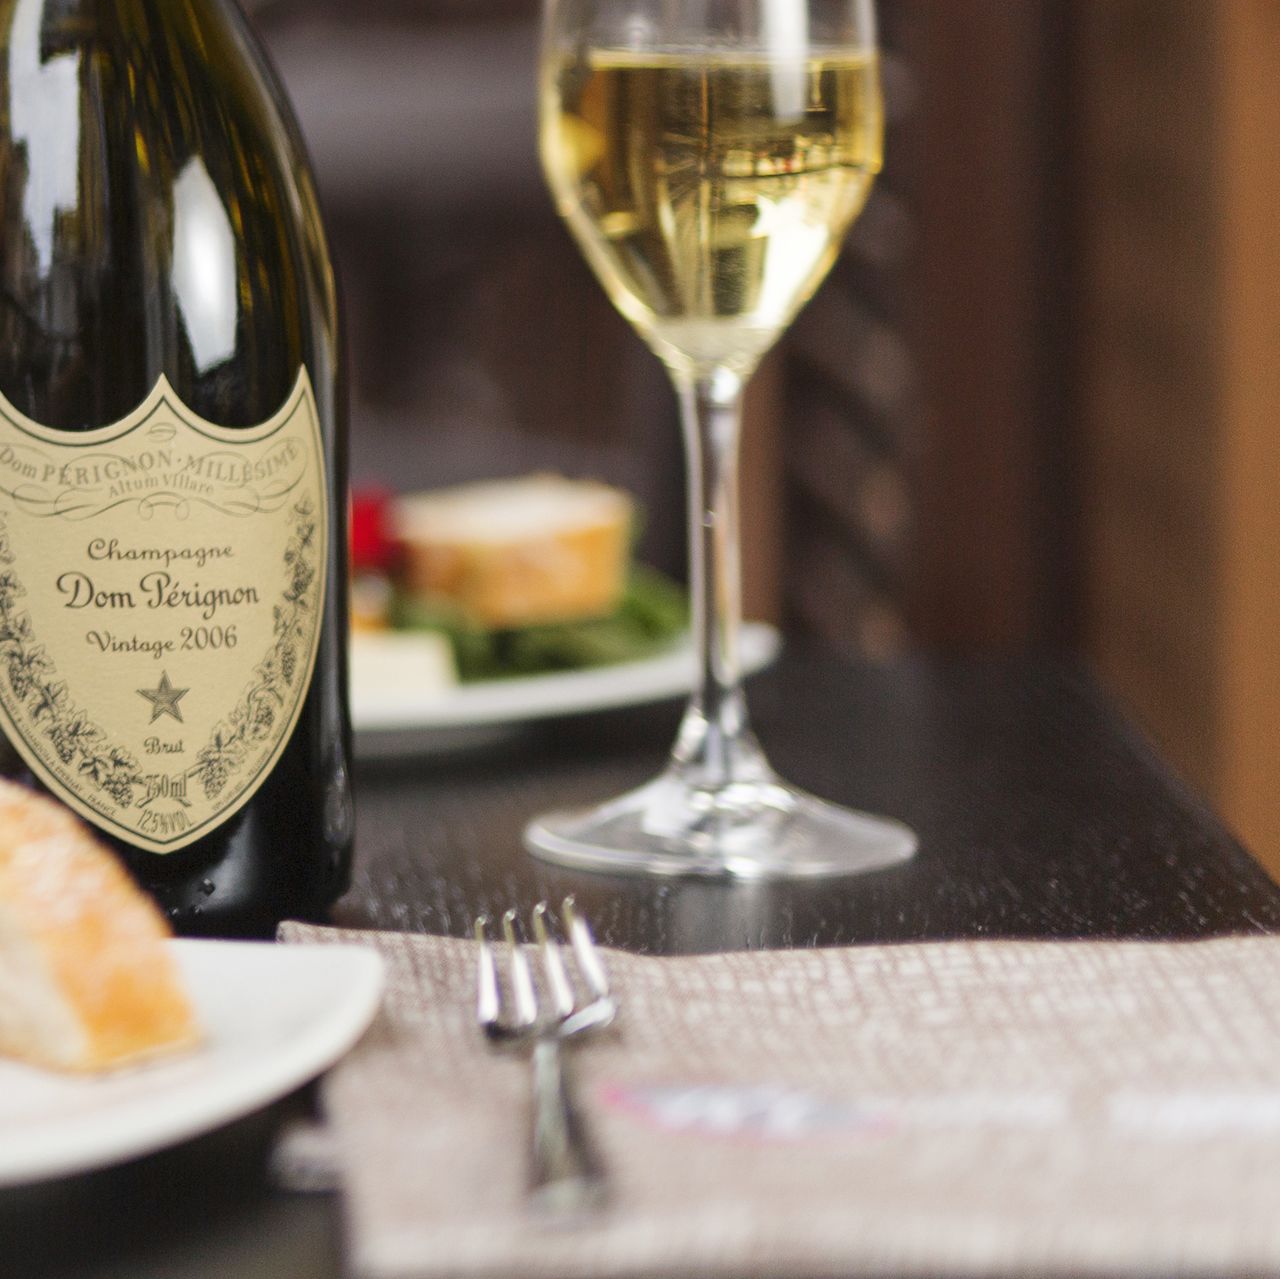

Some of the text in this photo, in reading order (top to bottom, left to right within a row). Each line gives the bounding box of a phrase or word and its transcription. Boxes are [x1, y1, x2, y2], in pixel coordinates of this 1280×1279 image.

[87, 537, 236, 568] Champagne
[55, 570, 260, 621] Dom Pérignon
[85, 624, 238, 660] Vintage 2006
[143, 736, 185, 754] Brut
[144, 773, 188, 799] 750ml
